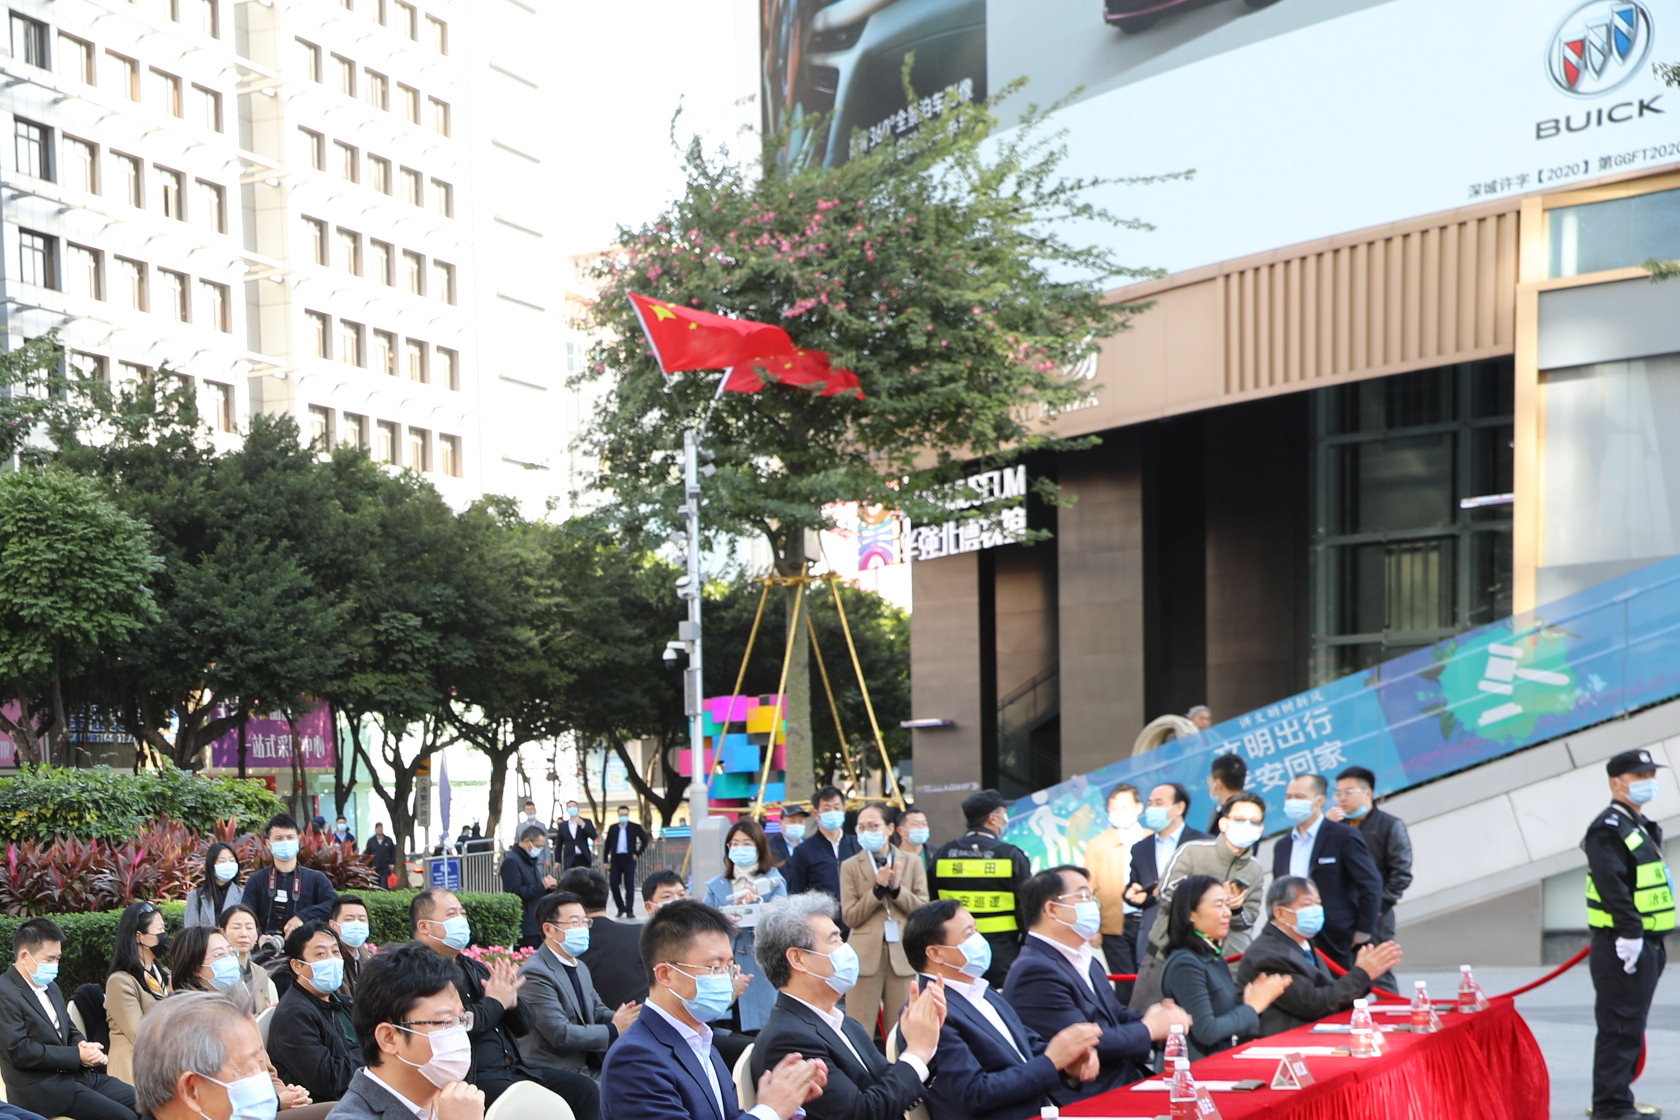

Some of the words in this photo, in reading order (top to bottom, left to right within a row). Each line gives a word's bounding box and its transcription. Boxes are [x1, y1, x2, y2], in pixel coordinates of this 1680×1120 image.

[1535, 94, 1666, 141] BUICK
[1244, 739, 1348, 793] 安回家
